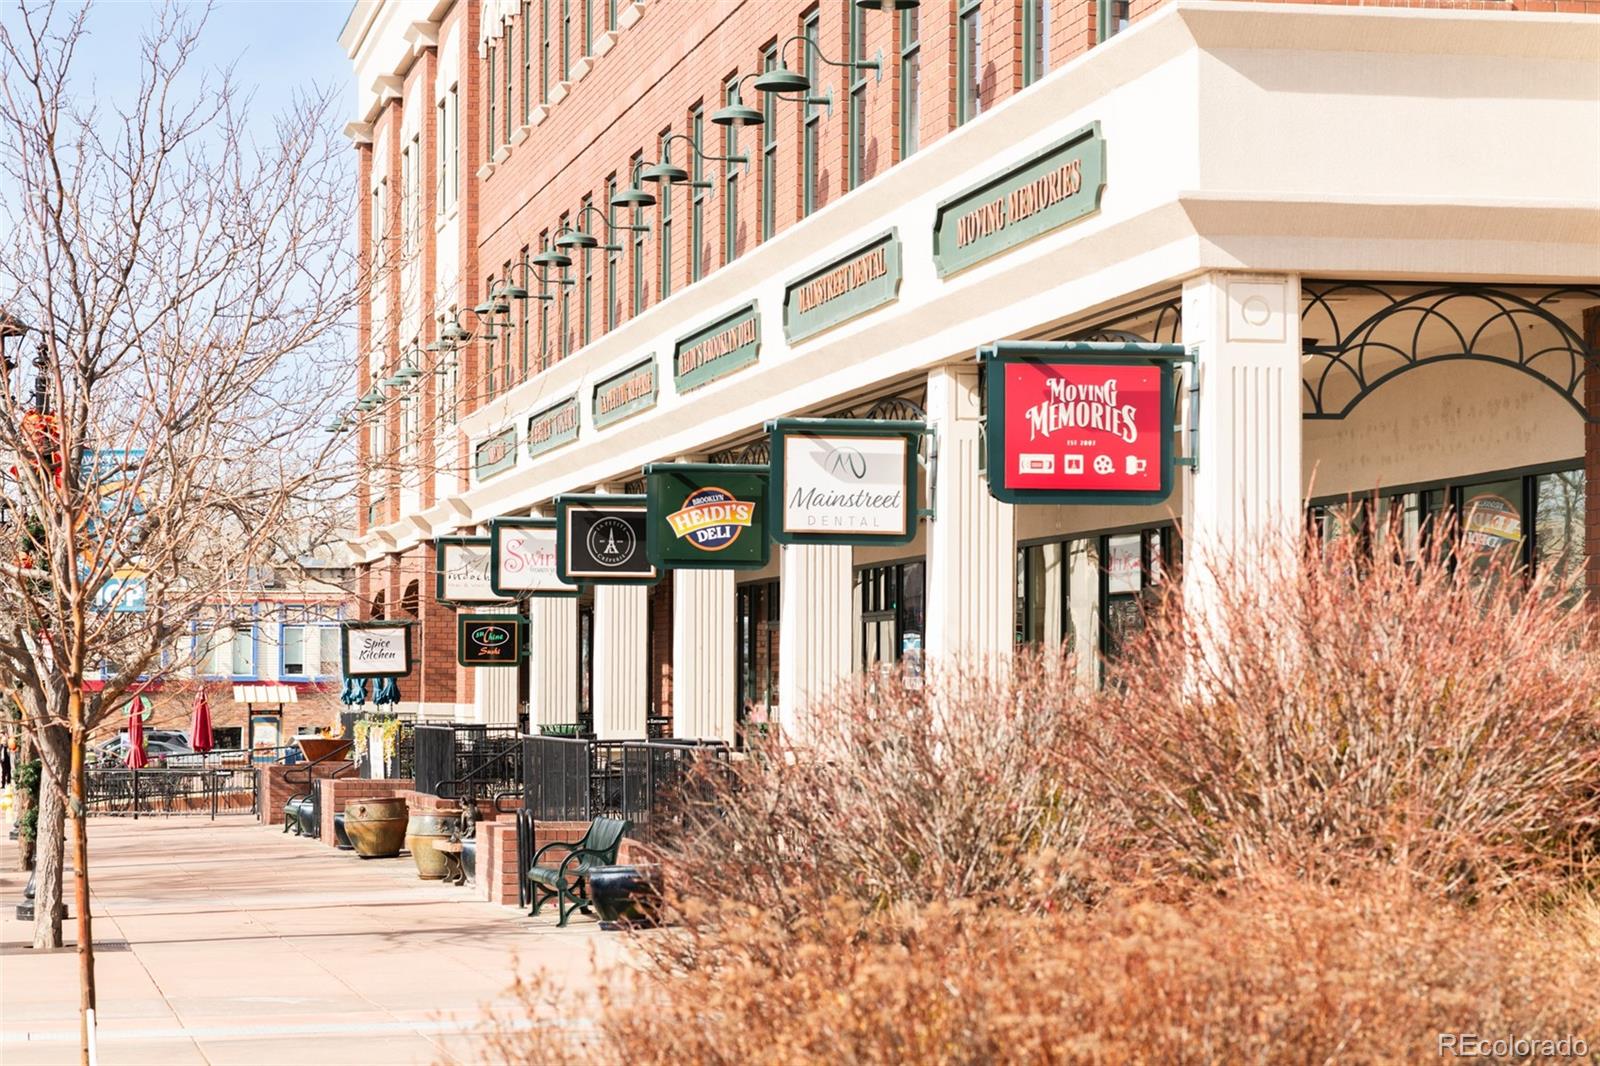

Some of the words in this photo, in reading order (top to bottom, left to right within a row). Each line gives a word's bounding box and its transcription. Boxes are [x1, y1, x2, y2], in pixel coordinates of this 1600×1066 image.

[956, 197, 1005, 249] MOVING
[1007, 158, 1082, 225] MEMORIES
[1025, 400, 1138, 444] MEMORIES
[692, 494, 725, 506] BROOKLYN
[789, 487, 901, 510] Mainstreet
[674, 504, 749, 531] HEIDI'S
[807, 515, 880, 528] DENTAL
[696, 525, 731, 542] DELI
[364, 638, 391, 651] Spice
[359, 648, 396, 660] Kitchen
